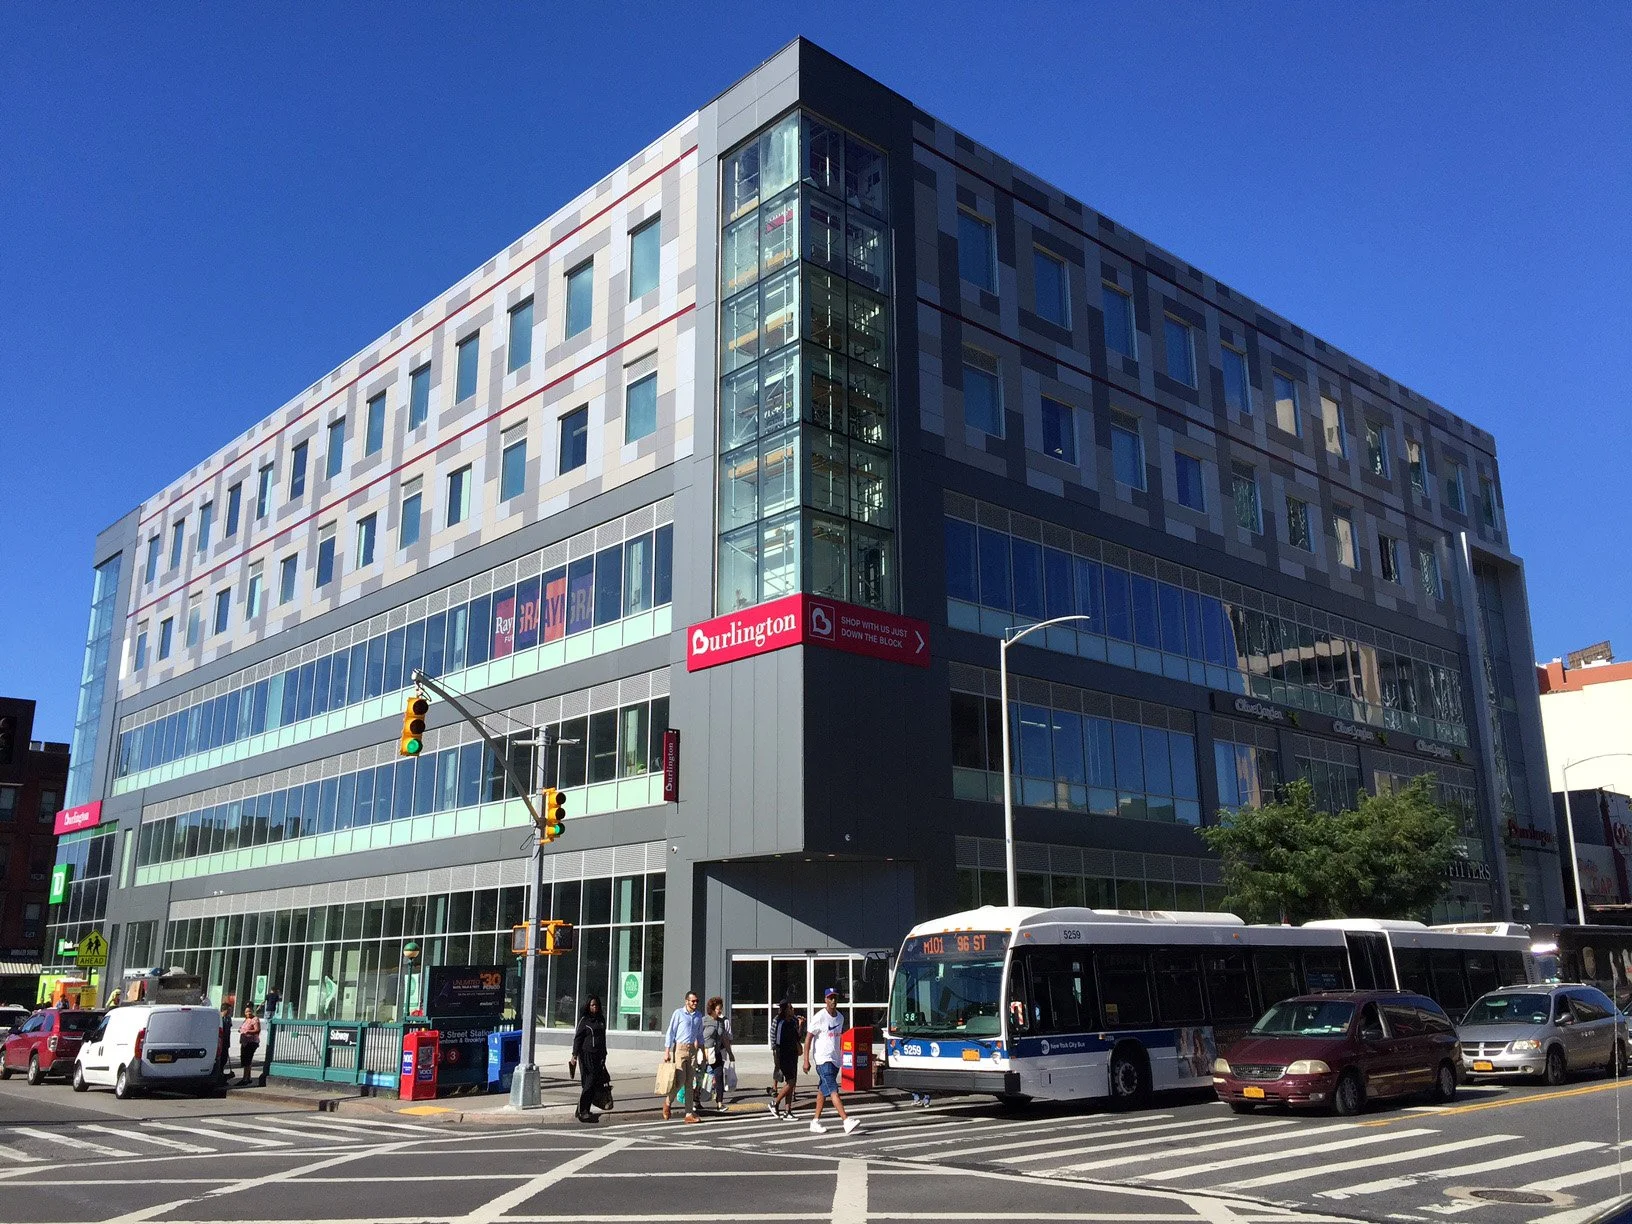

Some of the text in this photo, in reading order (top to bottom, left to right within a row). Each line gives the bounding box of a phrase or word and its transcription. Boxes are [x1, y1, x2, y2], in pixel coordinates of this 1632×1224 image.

[841, 616, 908, 637] SHOP WITH US JUST
[692, 613, 796, 655] Burlington
[841, 628, 903, 648] DOWN THE BLOCK
[665, 742, 675, 792] Burlington
[1063, 930, 1081, 940] 5259
[923, 935, 987, 954] M101 96 ST
[80, 957, 104, 965] AHEAD
[330, 1030, 350, 1043] Subway
[447, 1030, 468, 1039] Street
[903, 1044, 922, 1055] 5259
[1068, 1041, 1077, 1049] City
